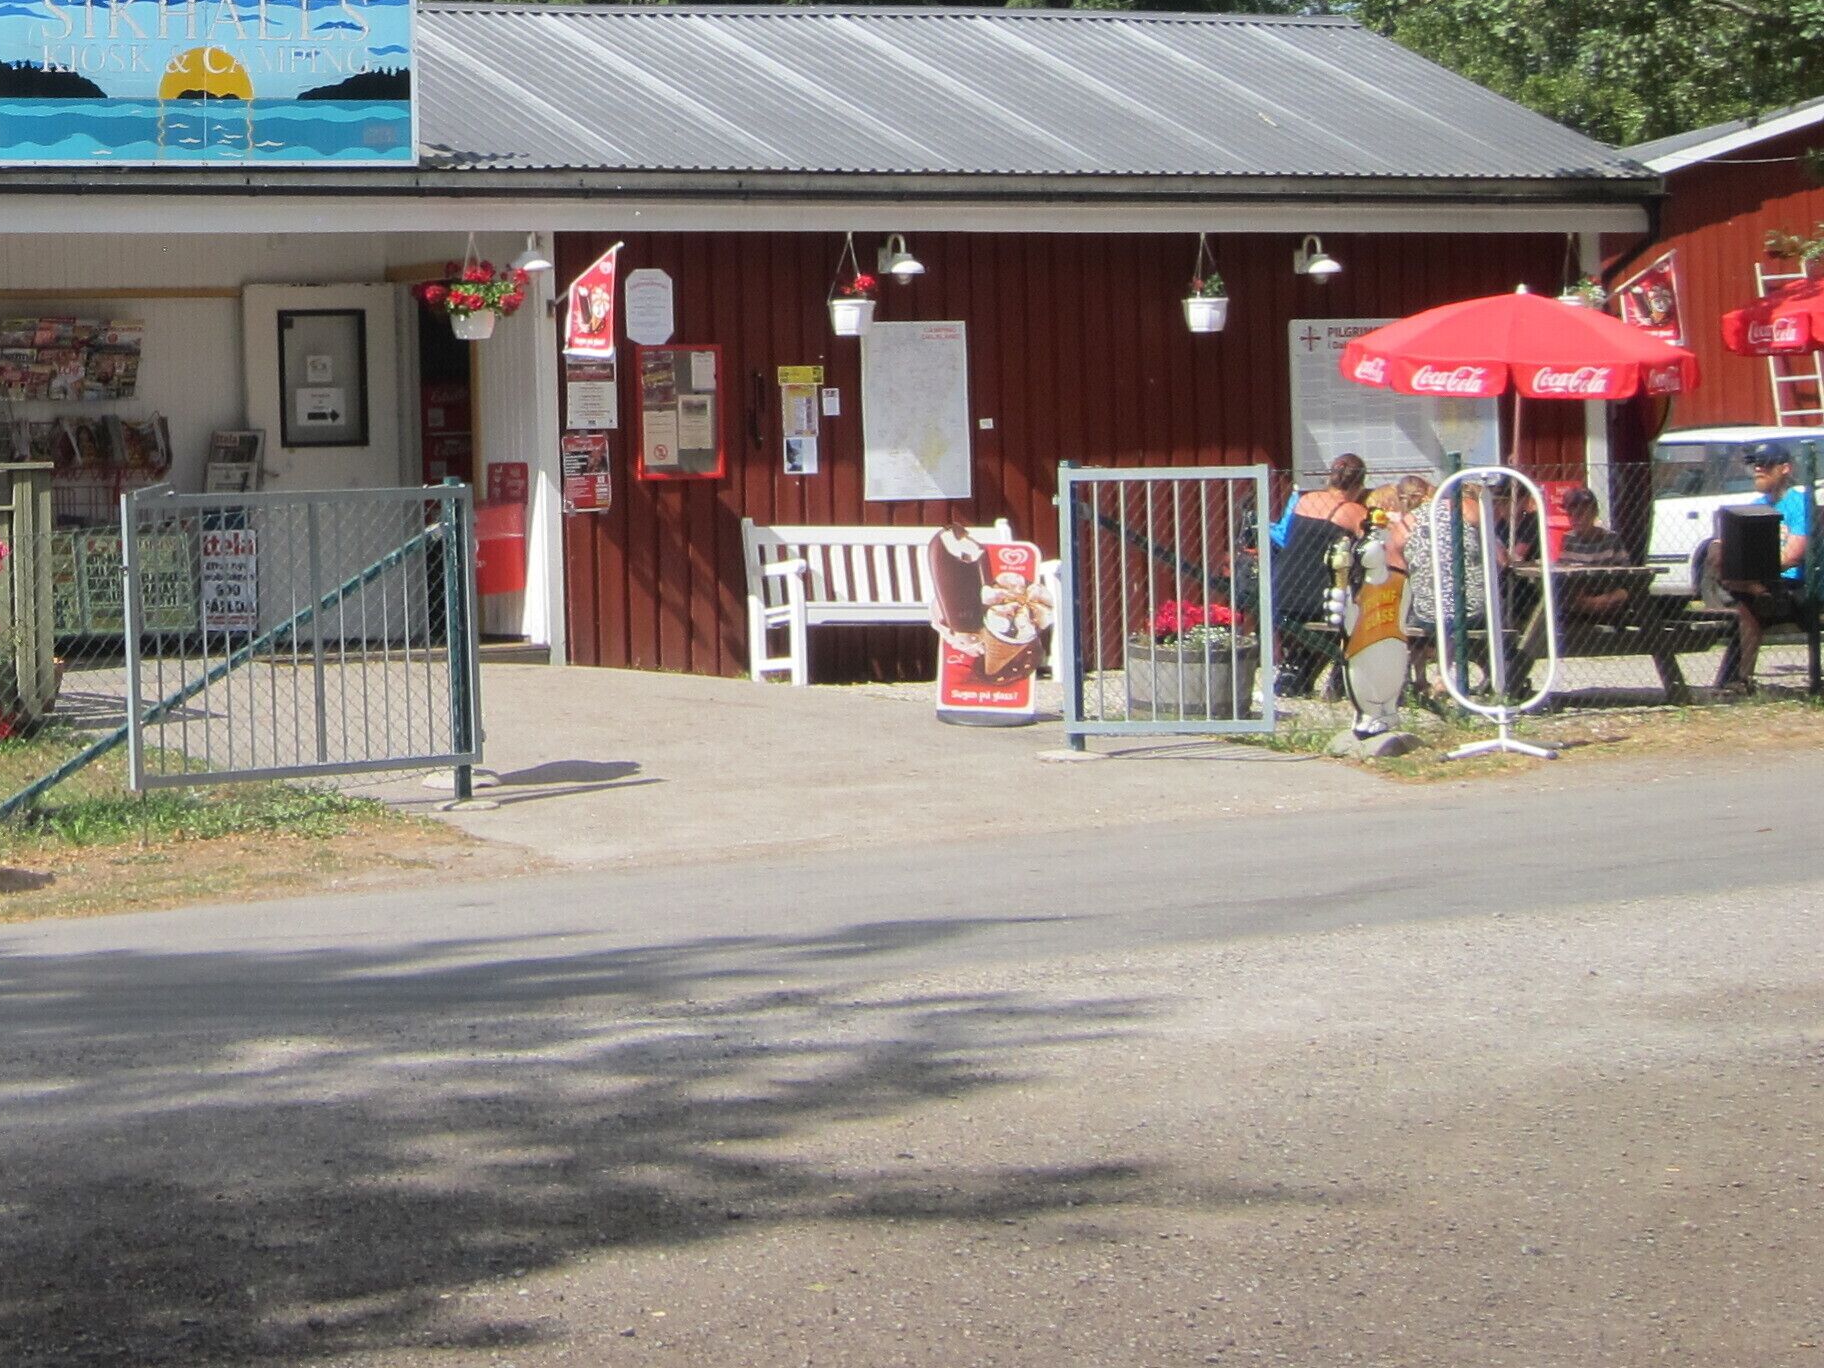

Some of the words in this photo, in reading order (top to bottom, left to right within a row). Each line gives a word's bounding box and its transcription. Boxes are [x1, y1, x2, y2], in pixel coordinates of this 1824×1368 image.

[40, 44, 153, 73] KIOSK
[165, 45, 190, 74] &
[203, 44, 371, 75] CAMPING
